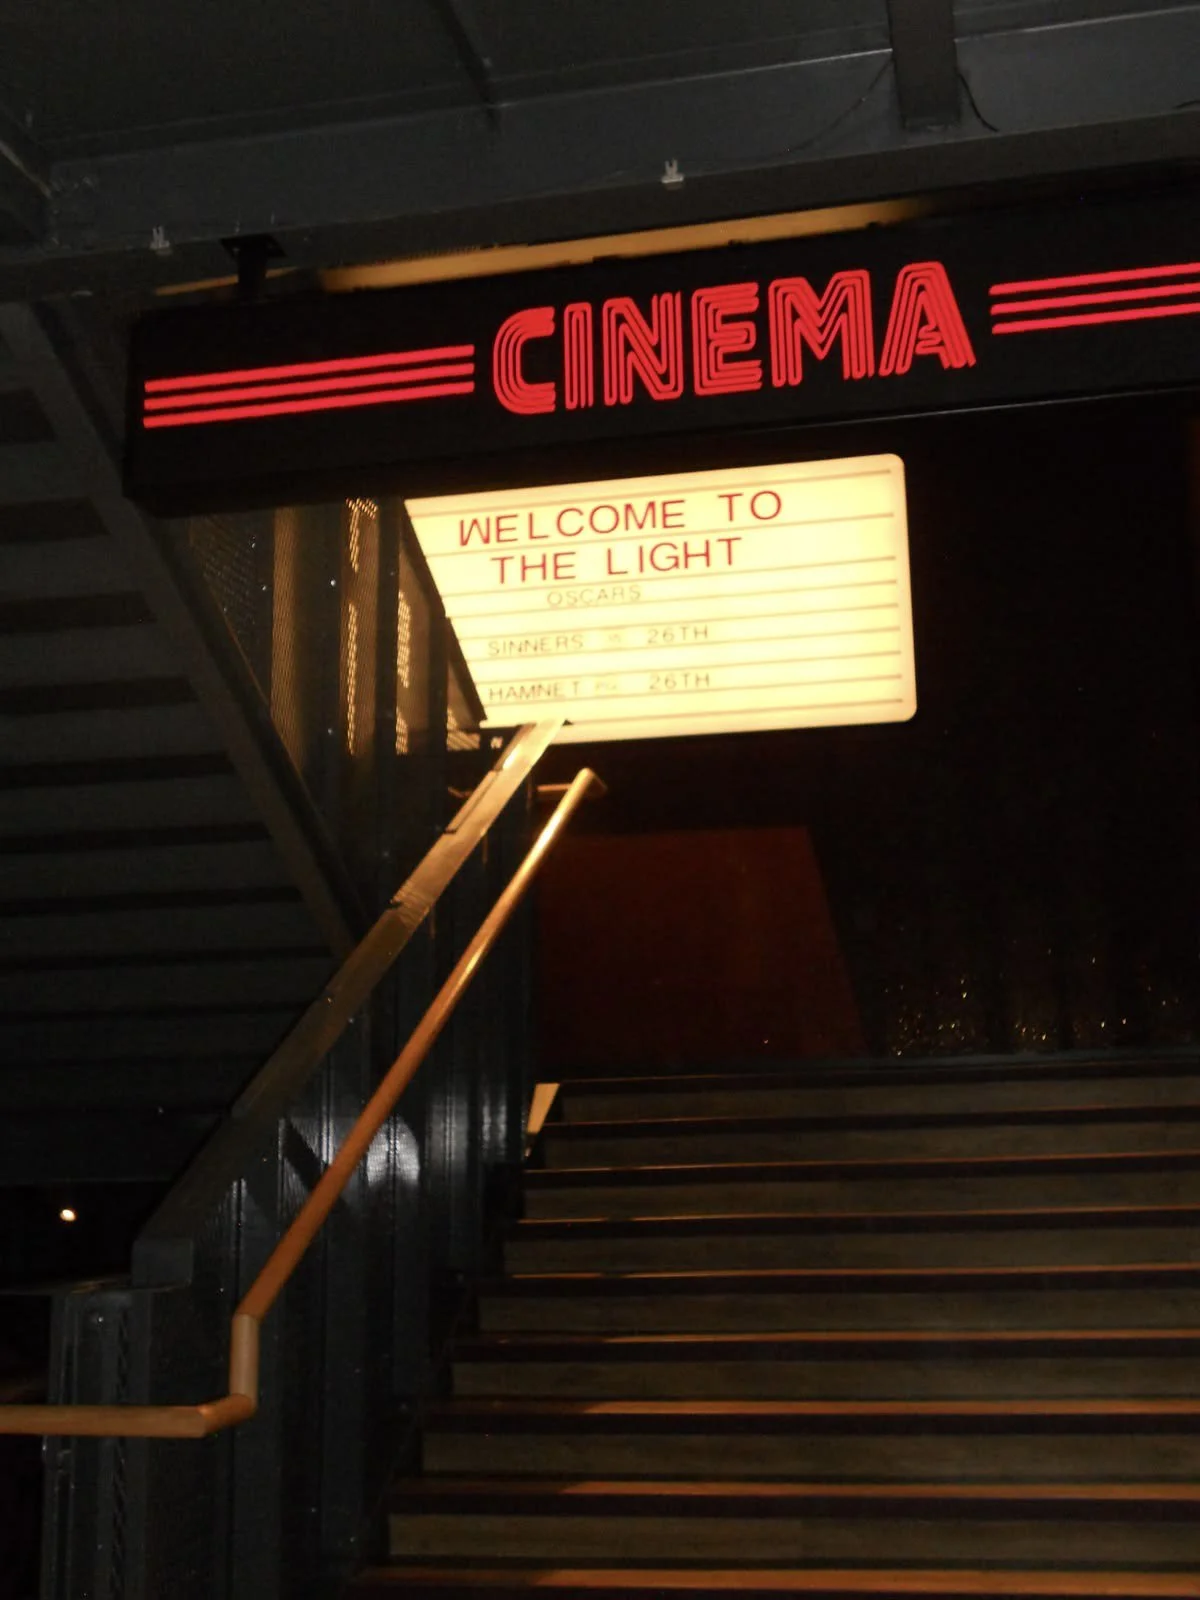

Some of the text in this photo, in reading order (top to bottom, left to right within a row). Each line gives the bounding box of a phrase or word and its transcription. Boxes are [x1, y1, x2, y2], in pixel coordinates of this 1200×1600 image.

[493, 261, 976, 415] CINEMA
[459, 490, 782, 546] WELCOME TO
[491, 537, 742, 584] THE LIGHT
[547, 584, 642, 606] OSCARS
[488, 634, 584, 657] SINNERS
[647, 625, 709, 644] 26TH
[489, 681, 580, 701] HAMNET
[649, 672, 710, 691] 26TH
